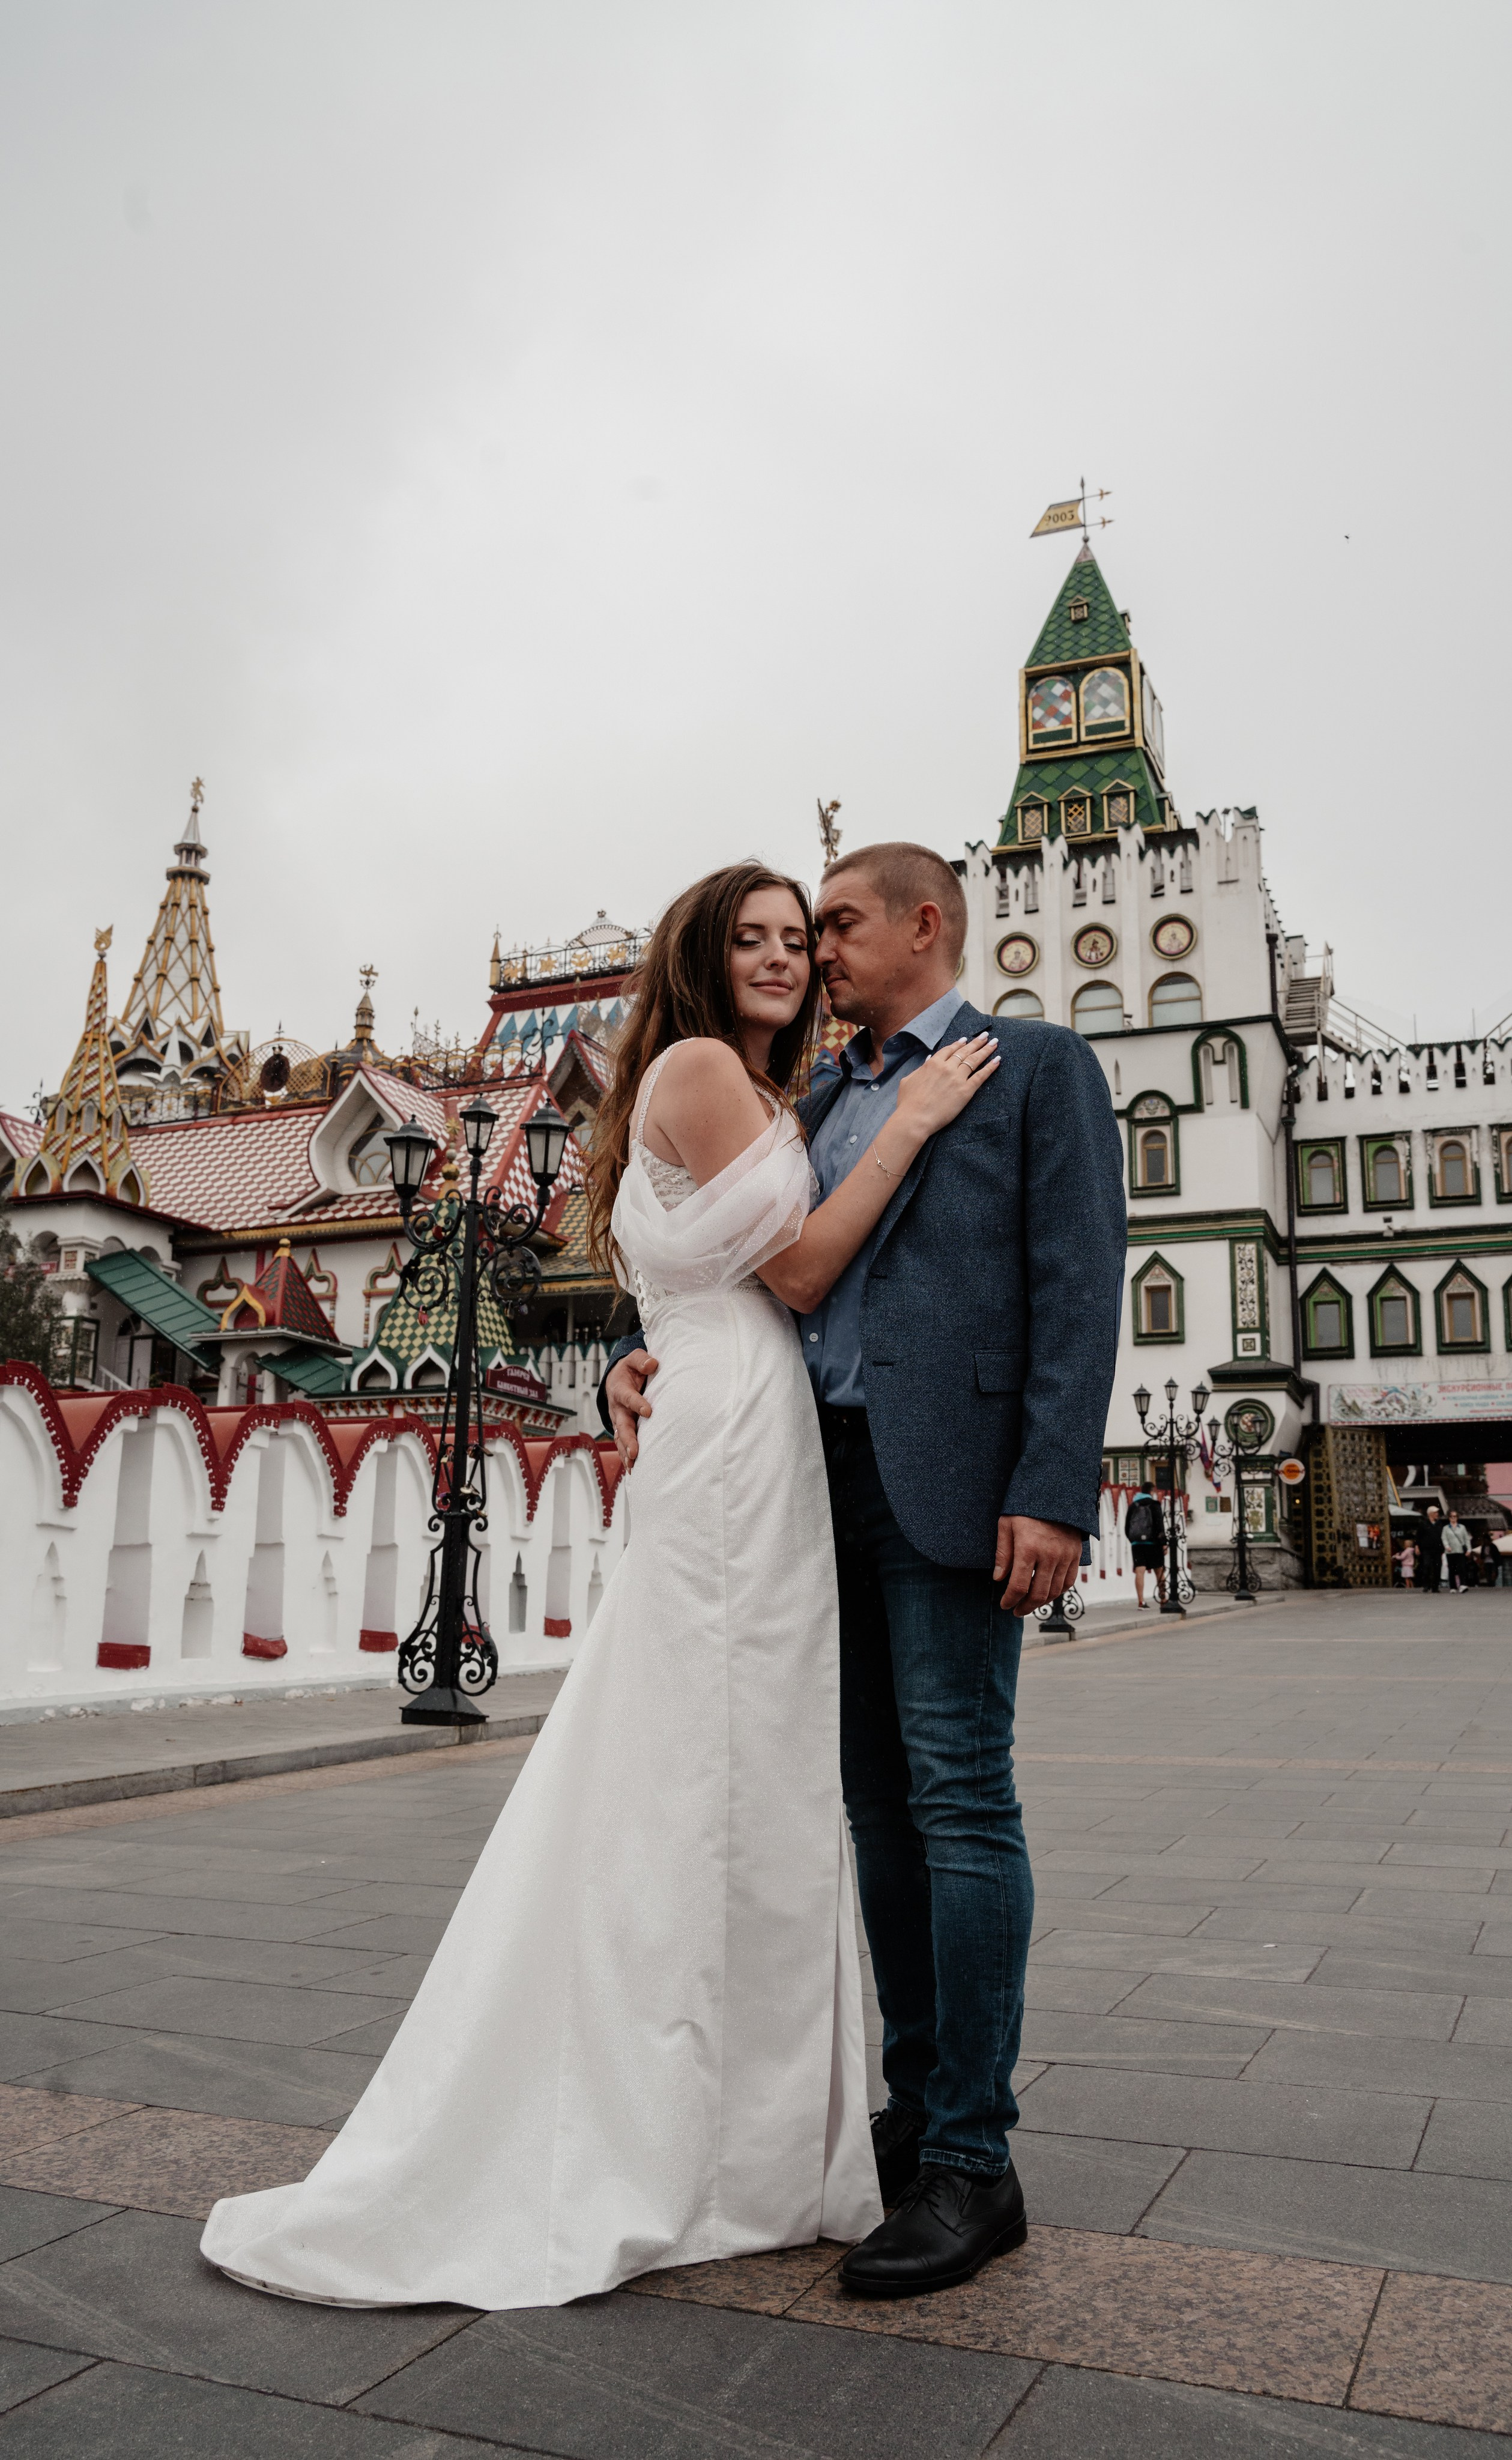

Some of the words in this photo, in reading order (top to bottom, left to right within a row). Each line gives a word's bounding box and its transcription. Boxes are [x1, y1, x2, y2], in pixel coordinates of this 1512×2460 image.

[507, 1368, 530, 1381] ГАЛЕРЕЯ
[497, 1380, 528, 1395] БАНКЕТНЫЙ
[529, 1389, 538, 1398] ЗАЛ
[1437, 1383, 1503, 1393] ЭКСКУРСИОННЫЕ
